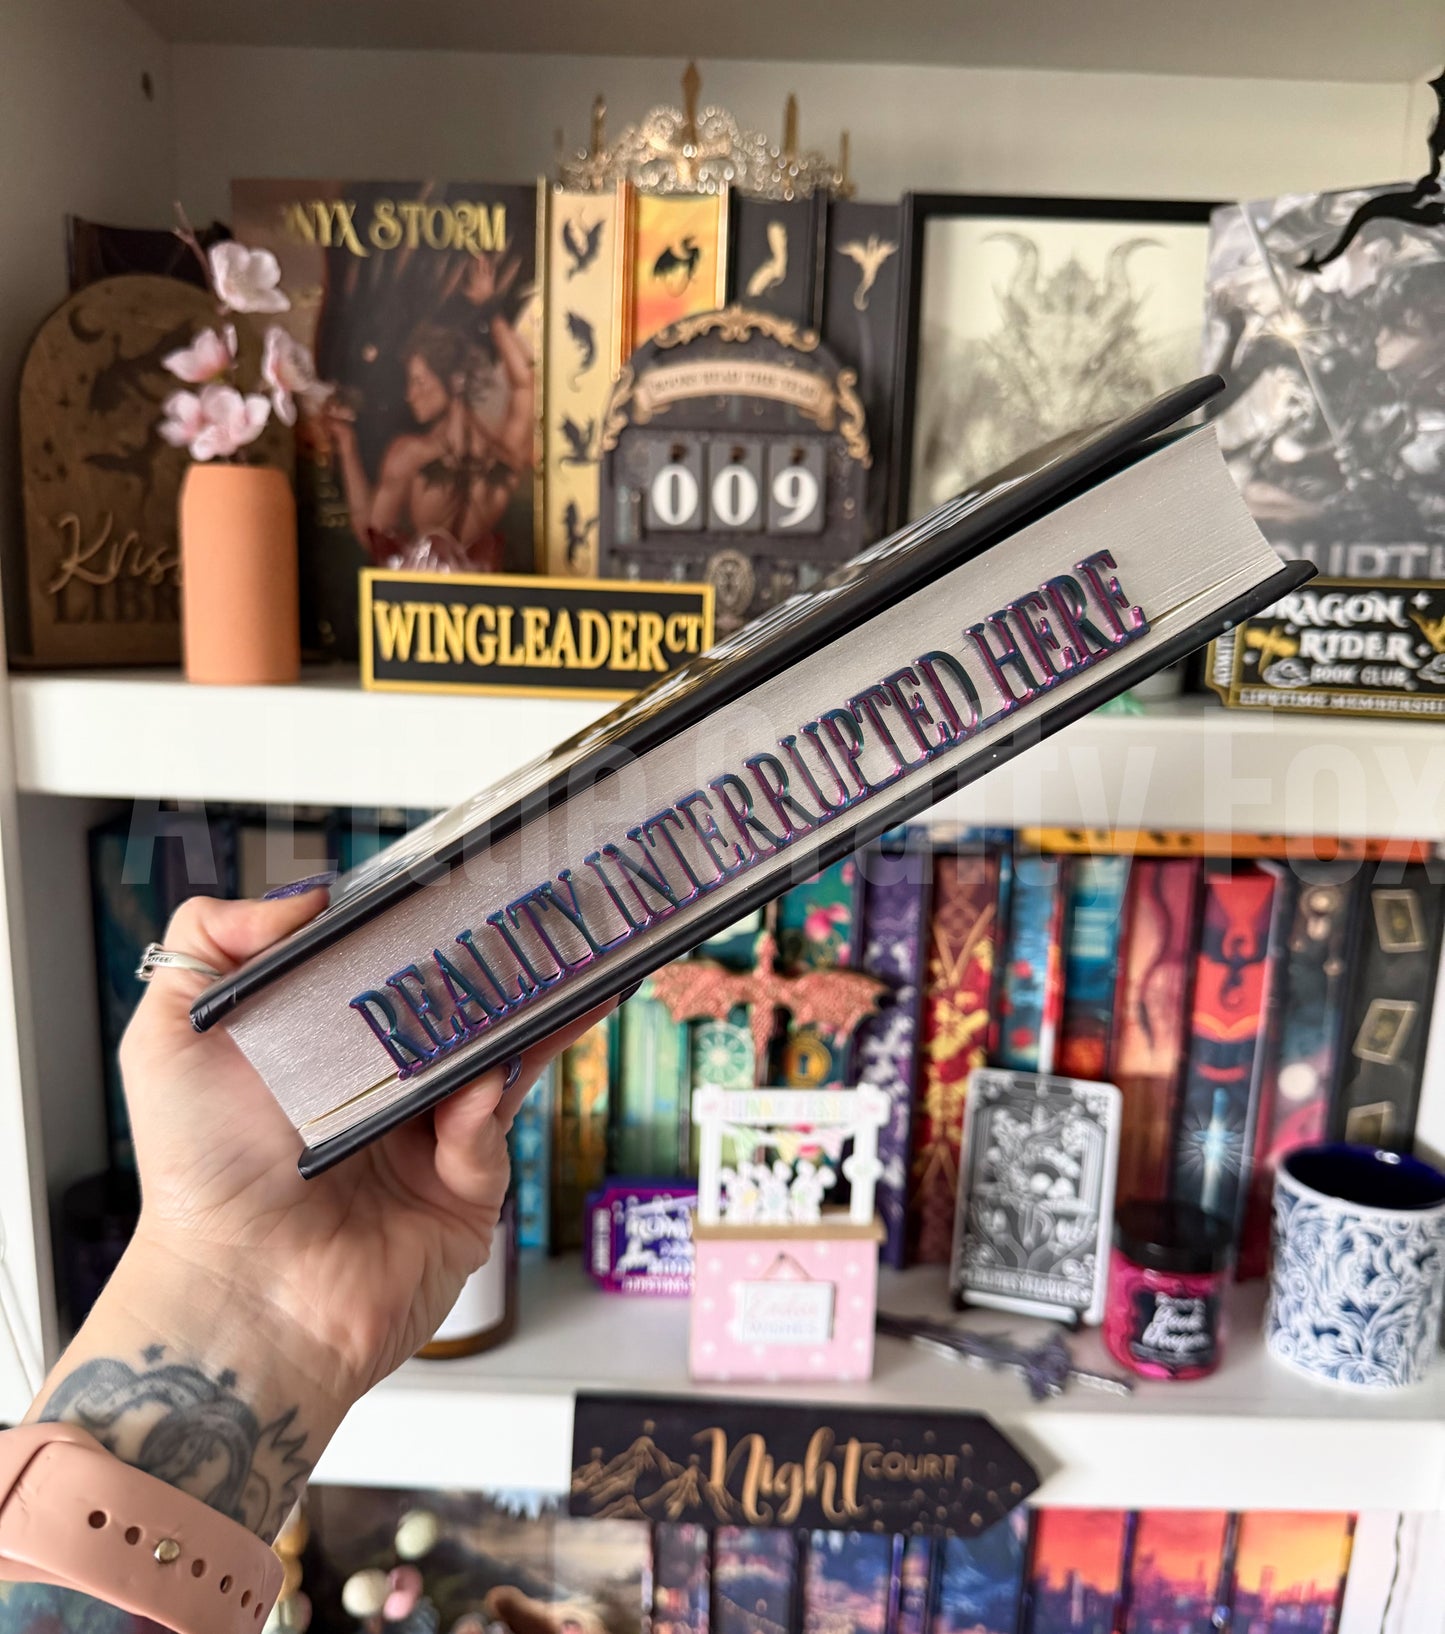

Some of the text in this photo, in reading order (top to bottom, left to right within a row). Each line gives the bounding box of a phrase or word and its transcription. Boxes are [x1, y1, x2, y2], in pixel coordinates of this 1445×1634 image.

[283, 198, 507, 259] NYX STORM
[651, 463, 819, 527] 009
[49, 511, 183, 594] Kris
[1300, 629, 1424, 668] RIDER
[1311, 664, 1358, 683] BOOK
[1330, 693, 1445, 714] MEMBERSHI
[352, 548, 1152, 1079] REALITY INTERRUPTED HERE
[692, 1427, 960, 1526] Night COURT
